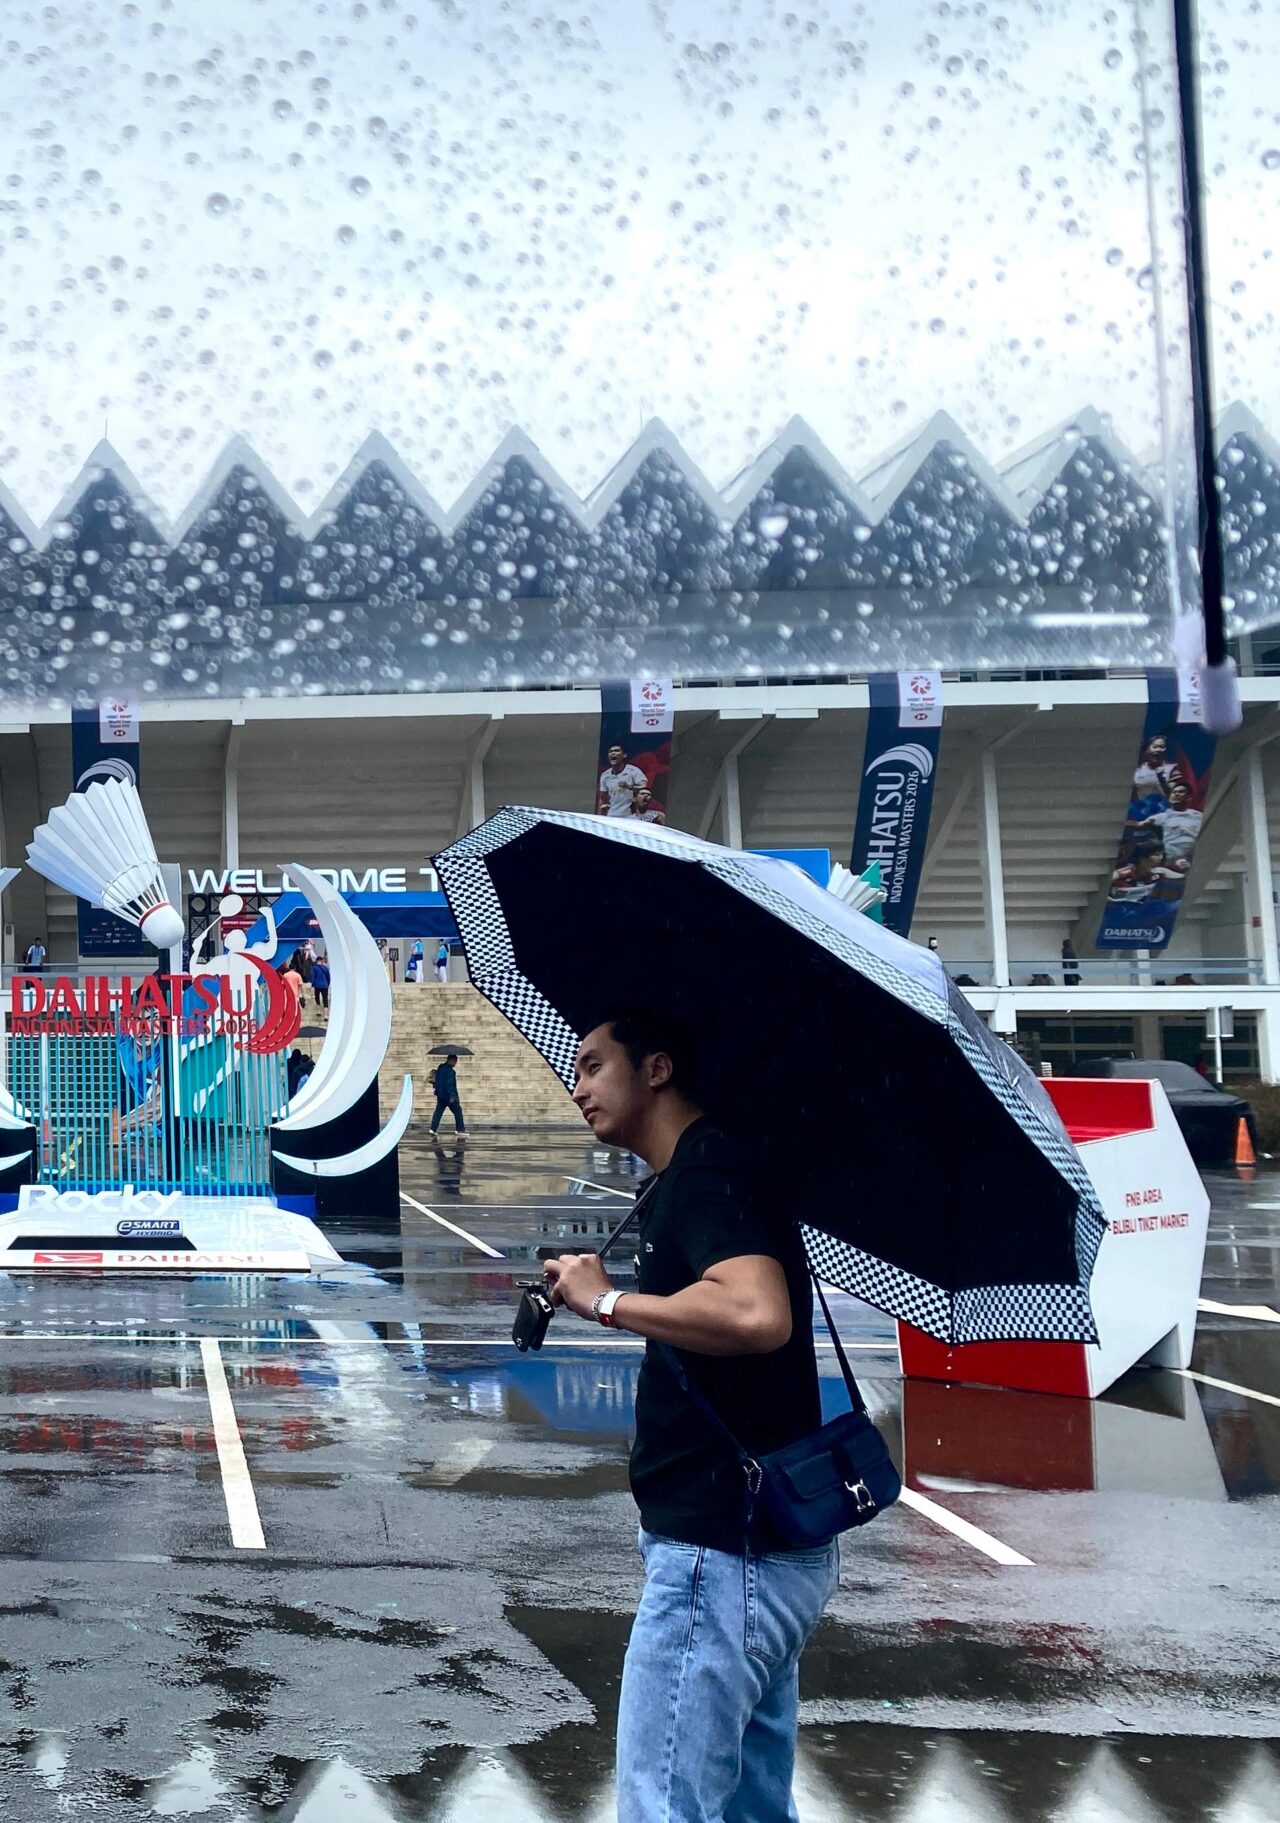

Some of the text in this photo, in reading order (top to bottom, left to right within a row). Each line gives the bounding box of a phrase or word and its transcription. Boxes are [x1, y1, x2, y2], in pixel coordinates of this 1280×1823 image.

[867, 772, 905, 903] AIHATSU
[890, 770, 919, 903] INDONESIA MASTERS 2026
[1104, 928, 1157, 937] DAIHATSU
[11, 973, 254, 1018] DAIHATSU
[11, 1018, 257, 1035] INDONESIA MASTERS 2026
[1125, 1188, 1164, 1208] FNB AREA
[1112, 1213, 1189, 1235] BLIBLI TIKET MARKET
[117, 1255, 265, 1263] DAIHATSU
